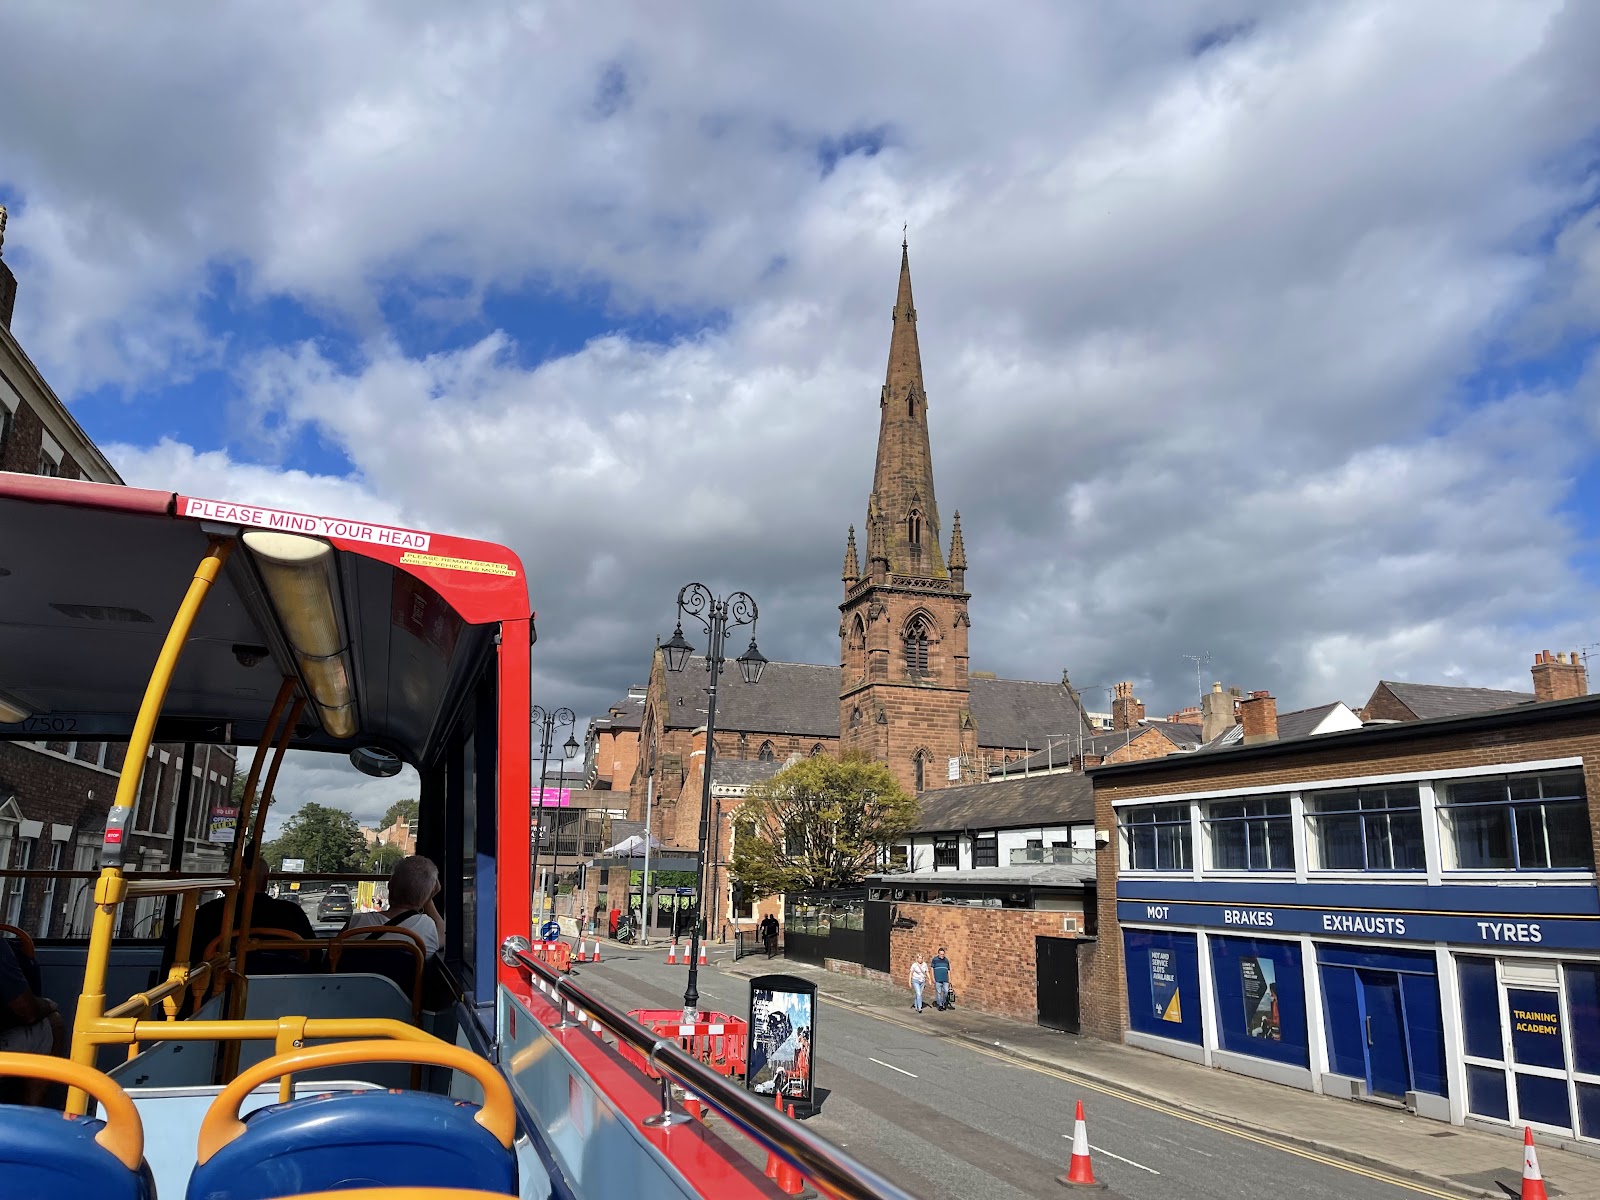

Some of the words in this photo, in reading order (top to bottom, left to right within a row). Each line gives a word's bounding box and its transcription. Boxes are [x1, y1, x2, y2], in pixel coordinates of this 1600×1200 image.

[190, 502, 263, 524] PLEASE
[269, 513, 317, 532] MIND
[323, 521, 373, 541] YOUR
[378, 530, 426, 548] HEAD
[406, 553, 439, 562] PLEASE
[441, 557, 473, 565] REMAIN
[474, 561, 507, 570] SEATED
[435, 562, 470, 570] VEHICLE
[481, 567, 515, 576] MOVING
[1147, 906, 1169, 919] MOT
[1224, 910, 1273, 926] BRAKES
[1322, 914, 1406, 935] EXHAUSTS
[1477, 921, 1542, 943] TYRES
[1152, 959, 1169, 967] SERVICE
[1160, 952, 1169, 960] AND
[1153, 972, 1175, 982] AVAILABLE
[1513, 1010, 1558, 1024] TRAINING
[1516, 1022, 1557, 1036] ACADEMY
